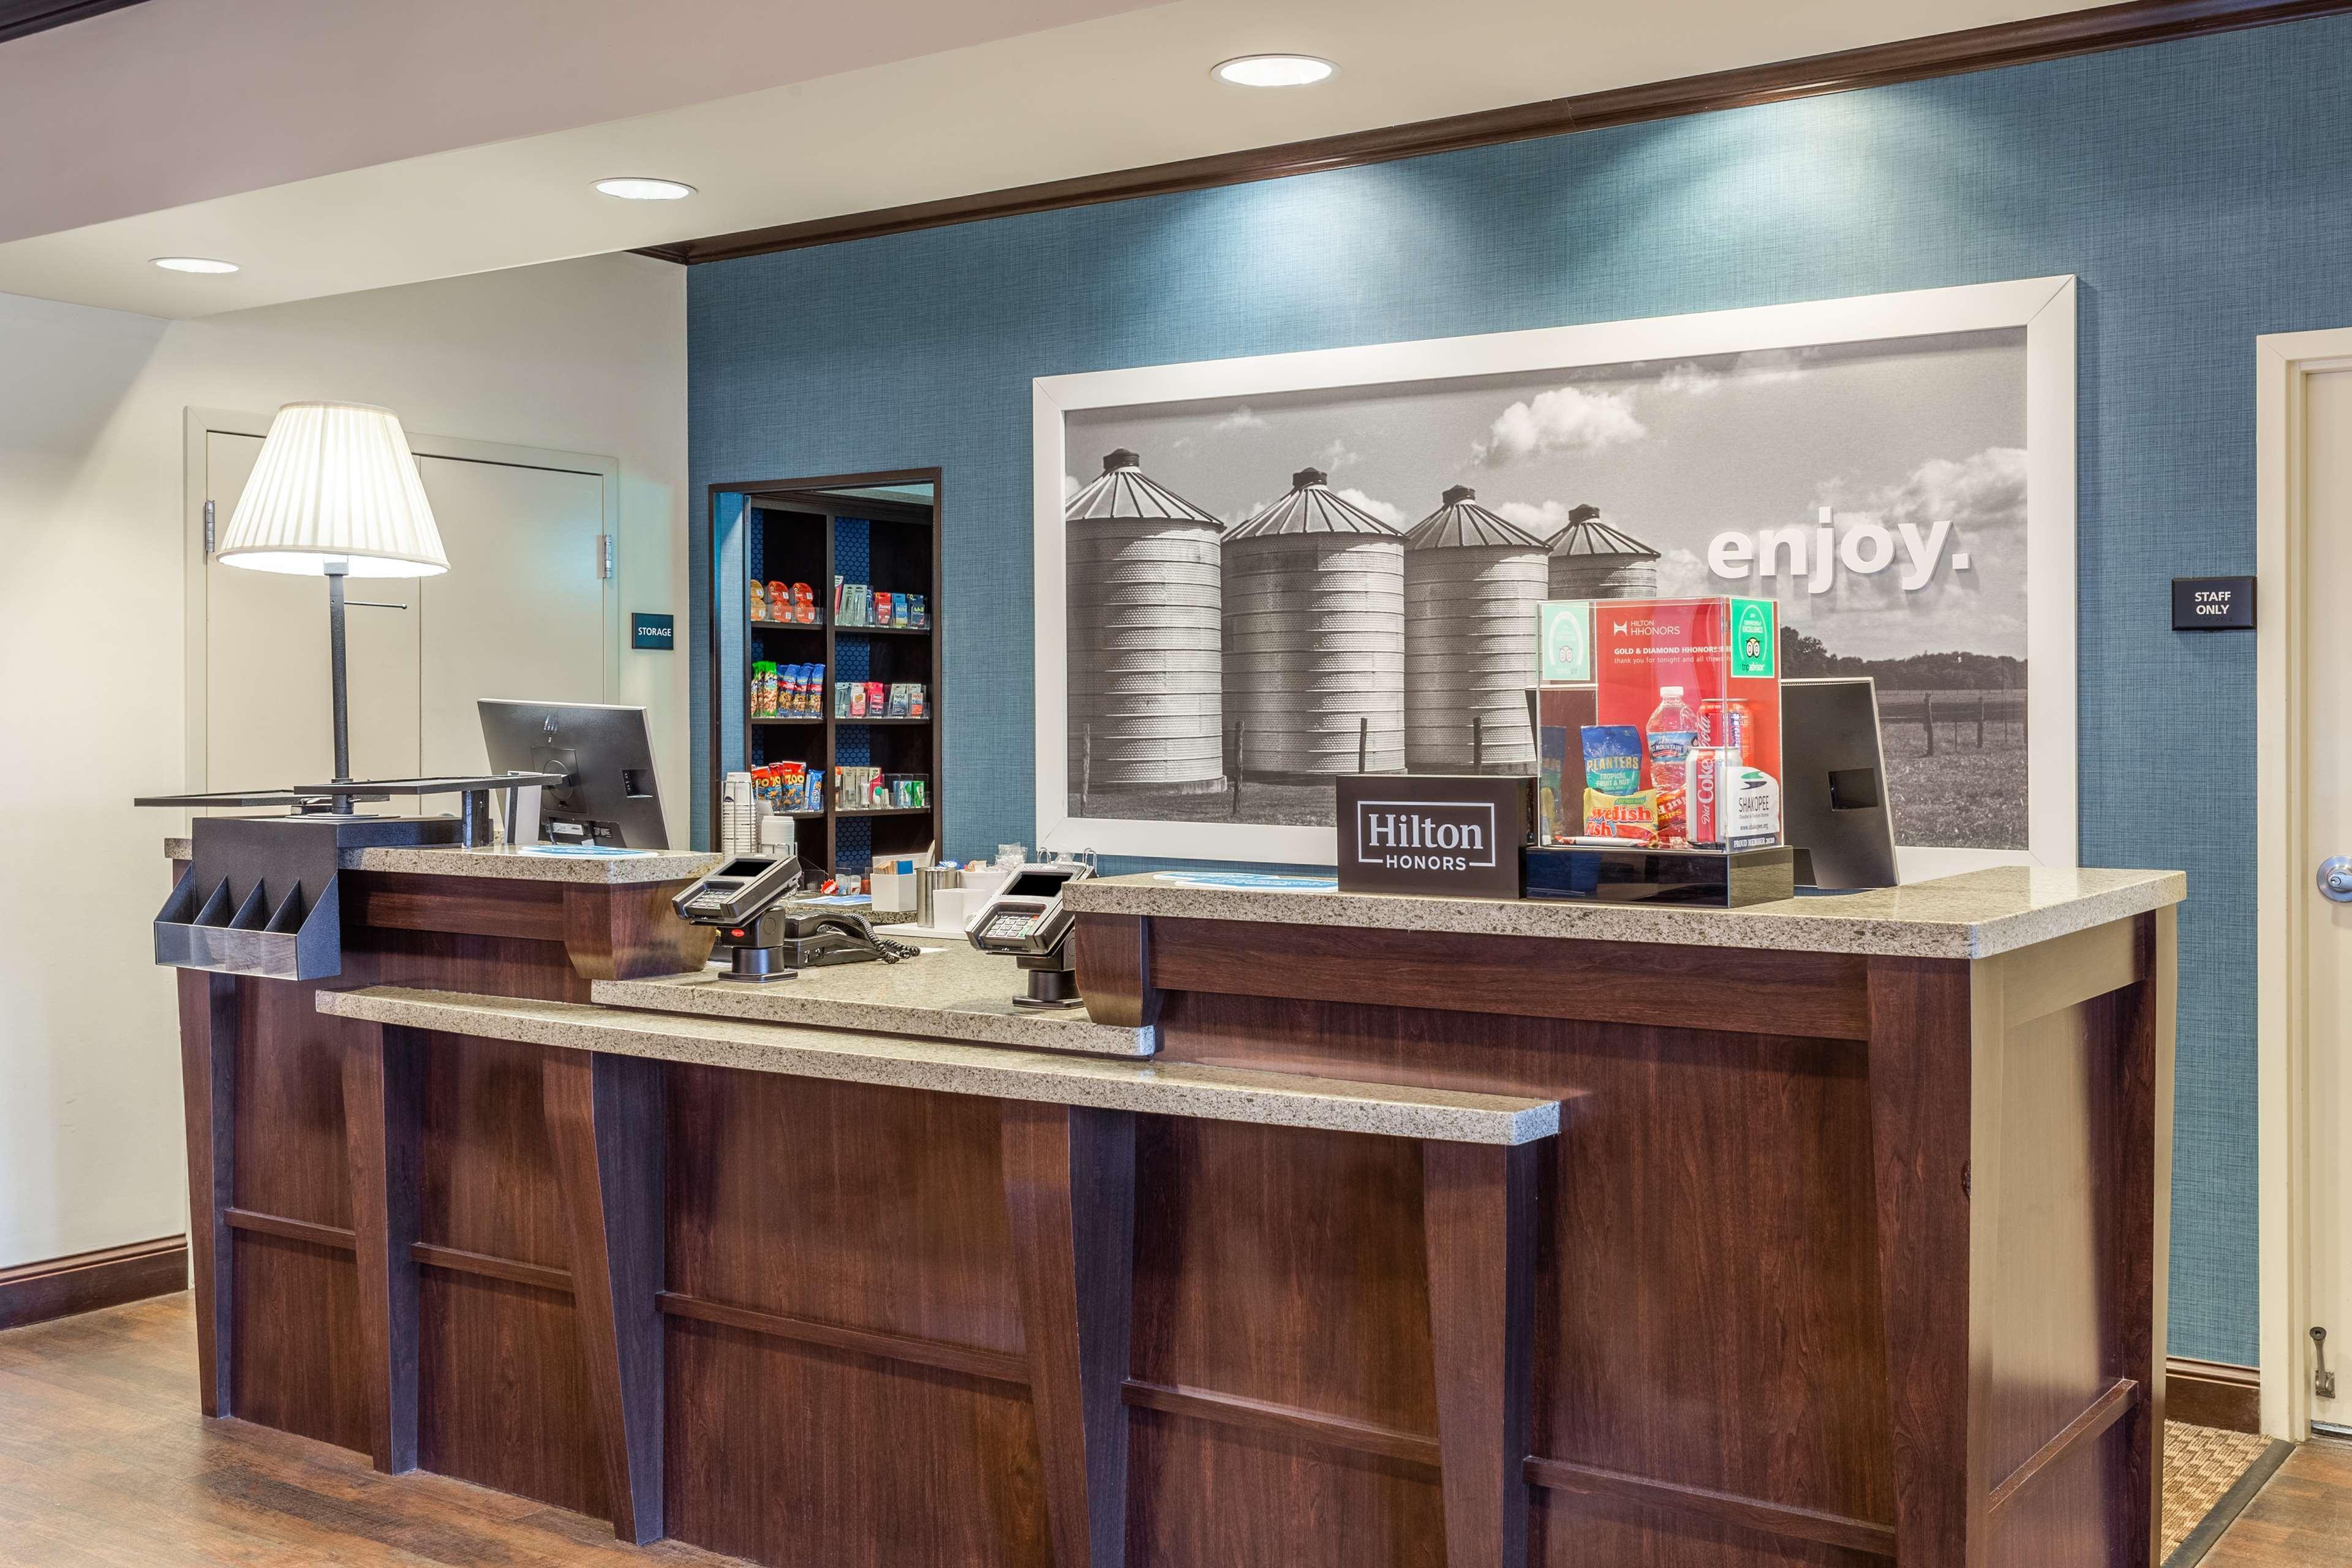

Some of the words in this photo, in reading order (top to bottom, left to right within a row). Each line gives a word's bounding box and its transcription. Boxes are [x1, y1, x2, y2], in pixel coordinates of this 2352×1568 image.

[1708, 507, 1970, 594] enjoy.
[2195, 591, 2231, 602] STAFF
[2196, 605, 2230, 615] ONLY
[638, 627, 671, 637] STORAGE
[1630, 626, 1681, 636] HHONORS
[1741, 662, 1765, 673] tripadvisor
[1586, 756, 1638, 772] PLANTERS
[785, 774, 804, 785] ZOO
[1697, 758, 1715, 804] Coke
[1739, 795, 1769, 813] SHAKOPEE
[1658, 809, 1683, 821] Salte
[1701, 804, 1711, 825] Diet
[1368, 813, 1483, 850] Hilton
[1733, 839, 1747, 848] PROUD
[1747, 837, 1765, 846] MEMBER
[1386, 854, 1467, 871] HONORS
